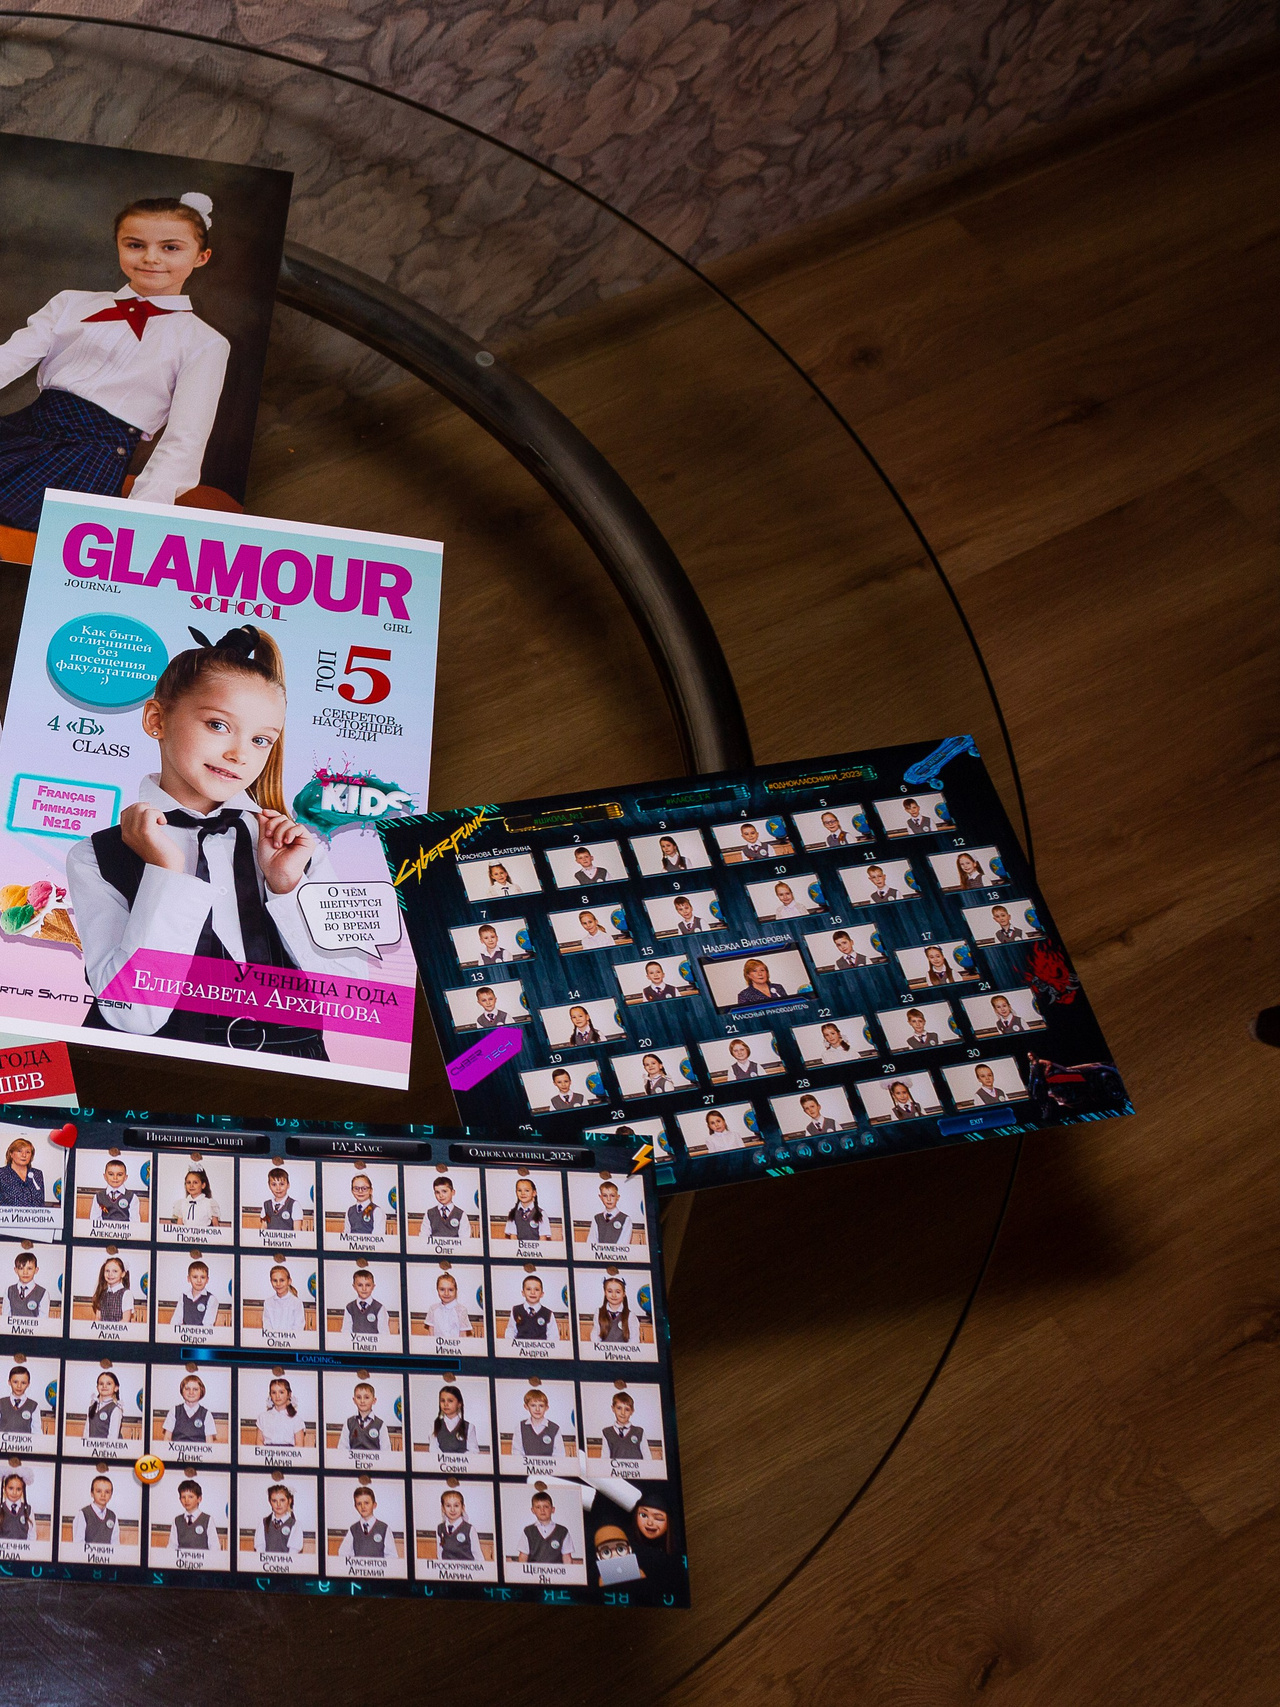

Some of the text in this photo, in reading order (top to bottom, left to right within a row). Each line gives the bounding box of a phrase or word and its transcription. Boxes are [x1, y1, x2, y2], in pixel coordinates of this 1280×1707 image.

[62, 522, 413, 621] GLAMOUR
[65, 578, 121, 593] JOURNAL
[190, 595, 287, 621] SCHOOL
[82, 625, 142, 642] Как быть
[383, 623, 412, 634] GIRL
[69, 634, 152, 654] отличницей
[97, 647, 118, 657] без
[70, 653, 145, 670] посещения
[56, 660, 158, 682] факультативов
[315, 650, 337, 692] ТОП
[338, 645, 391, 705] 5
[322, 708, 395, 725] СЕКРЕТОВ
[47, 715, 60, 731] 4
[312, 716, 403, 737] НАСТОЯЩЕЙ
[336, 728, 377, 742] ЛЕДИ
[72, 739, 130, 758] CLASS
[900, 785, 907, 793] 6
[740, 810, 746, 818] 4
[42, 816, 81, 831] №16
[659, 821, 666, 829] 3
[573, 835, 580, 843] 2
[953, 838, 965, 847] 12
[775, 866, 787, 874] 10
[673, 882, 680, 890] 9
[342, 887, 366, 896] ЧЁМ
[320, 899, 382, 908] ШЕПЧУТСЯ
[326, 910, 379, 920] ДЕВОЧКИ
[325, 921, 380, 931] ВО ВРЕМЯ
[338, 933, 375, 942] УРОКА
[921, 931, 933, 941] 17
[641, 947, 653, 955] 15
[471, 972, 484, 982] 13
[979, 982, 991, 991] 24
[345, 985, 399, 1006] ГОДА
[900, 994, 914, 1003] 23
[639, 1038, 652, 1047] 20
[967, 1049, 980, 1057] 30
[796, 1079, 810, 1088] 28
